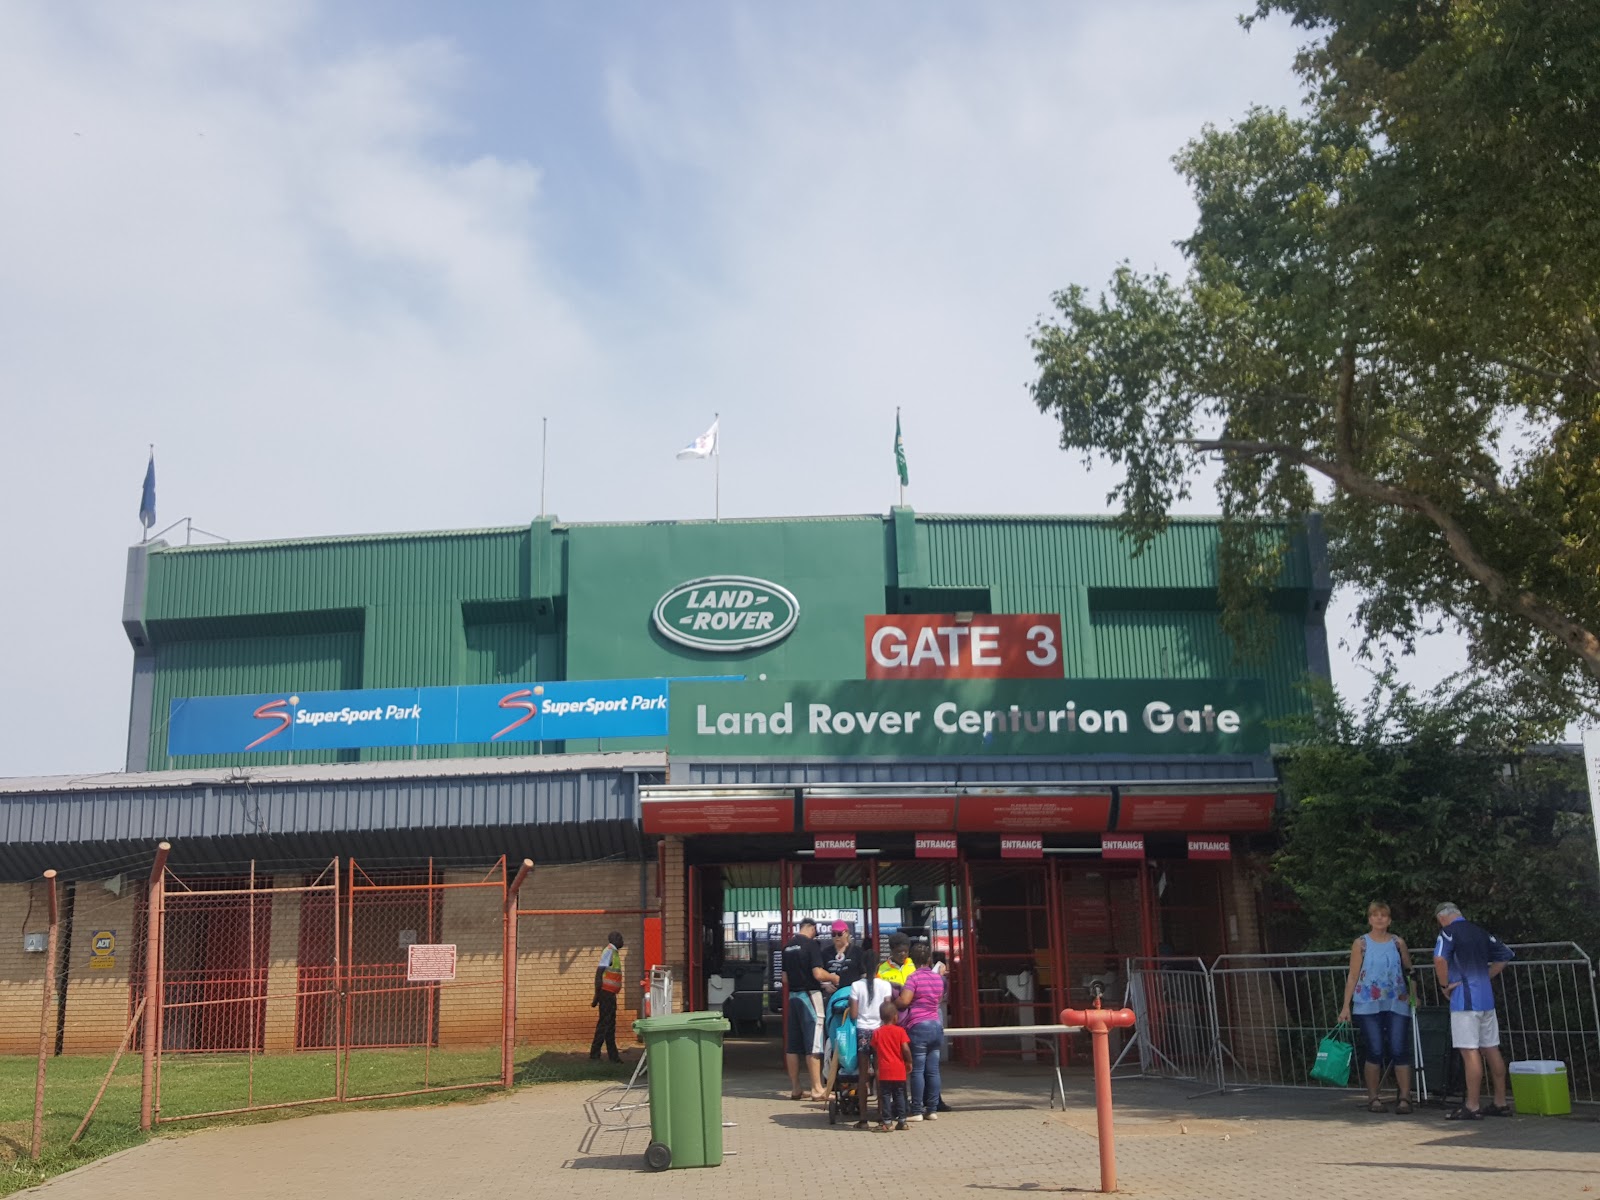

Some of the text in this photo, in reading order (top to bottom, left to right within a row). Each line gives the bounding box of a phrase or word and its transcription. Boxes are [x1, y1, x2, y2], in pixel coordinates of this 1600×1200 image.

[686, 590, 754, 609] LAND
[692, 611, 774, 630] ROVER
[871, 625, 1057, 667] GATE 3
[541, 697, 628, 716] SuperSport
[631, 694, 667, 710] Park
[296, 707, 383, 726] SuperSport
[385, 703, 422, 720] Park
[697, 700, 1240, 735] Land Rover Centurion Gate
[815, 840, 856, 849] ENTRANCE
[915, 839, 957, 849] ENTRANCE
[1001, 840, 1042, 849] ENTRANCE
[1102, 840, 1144, 849] ENTRANCE
[1188, 841, 1230, 851] ENTRANCE
[96, 939, 111, 948] ADT
